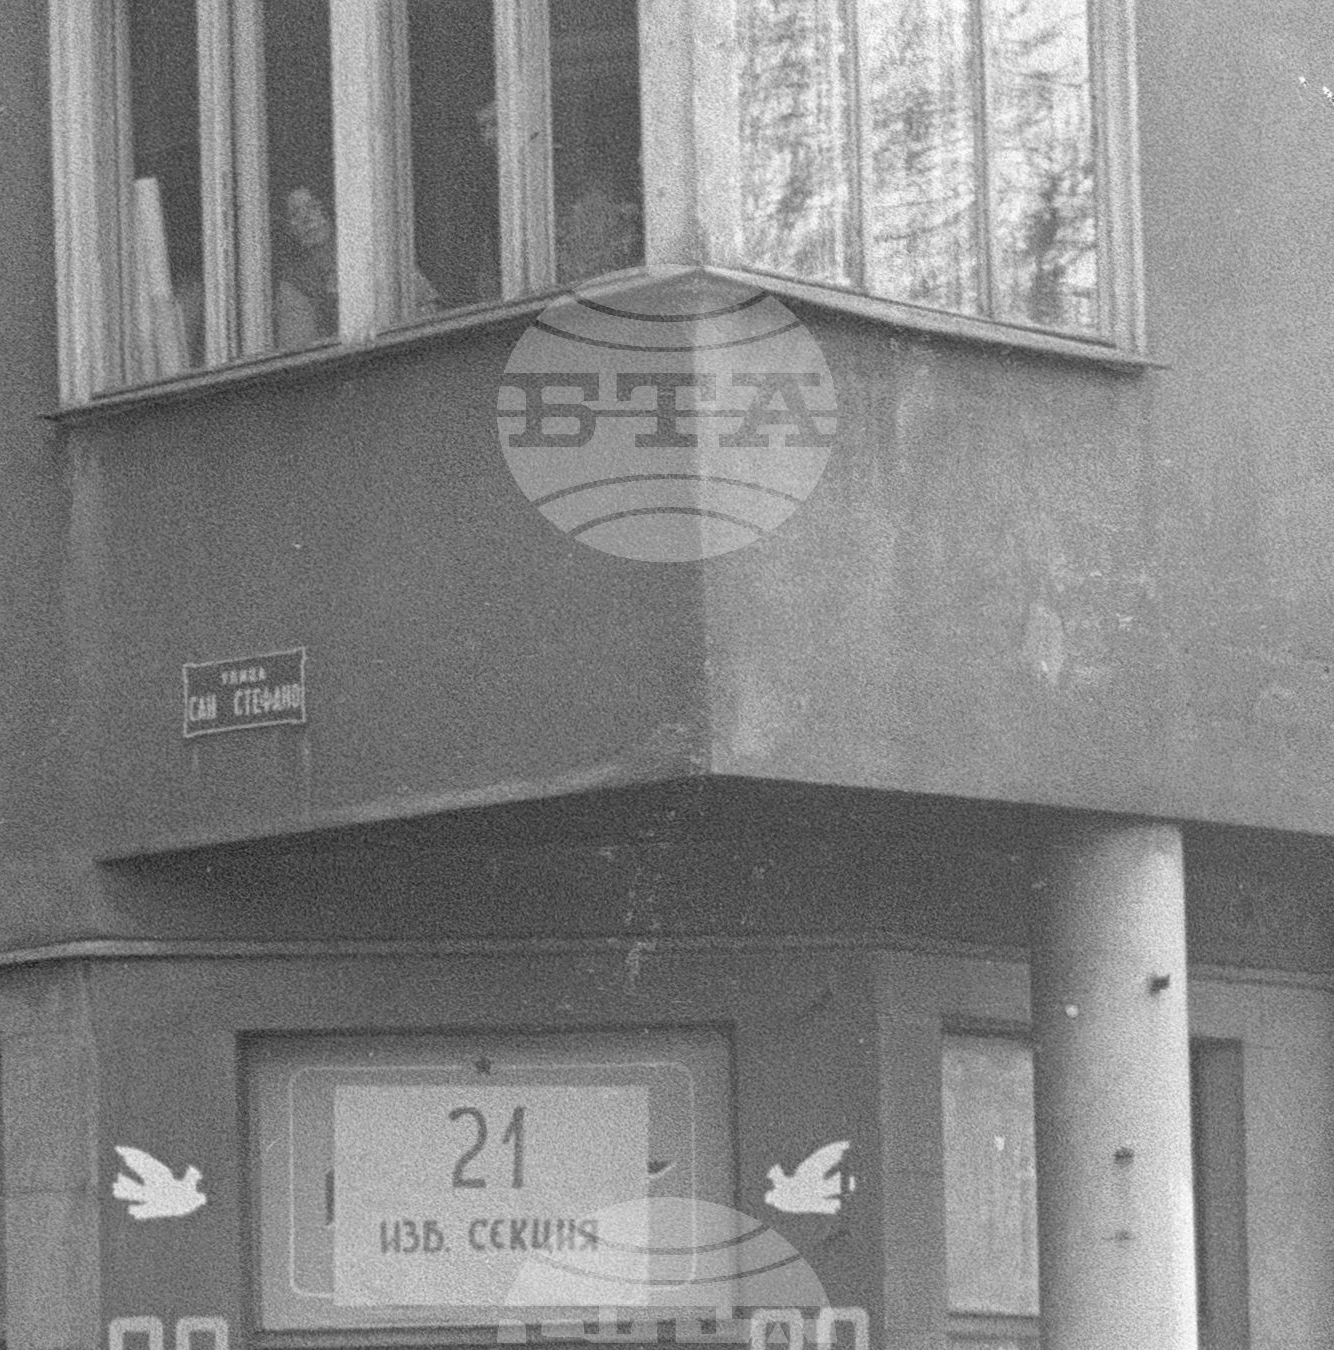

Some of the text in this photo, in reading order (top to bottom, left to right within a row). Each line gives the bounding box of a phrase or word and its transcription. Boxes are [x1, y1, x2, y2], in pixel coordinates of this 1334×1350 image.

[189, 683, 301, 721] САН СТЕФАНО
[448, 1106, 525, 1189] 21
[469, 1217, 599, 1252] СЕКЦИЯ
